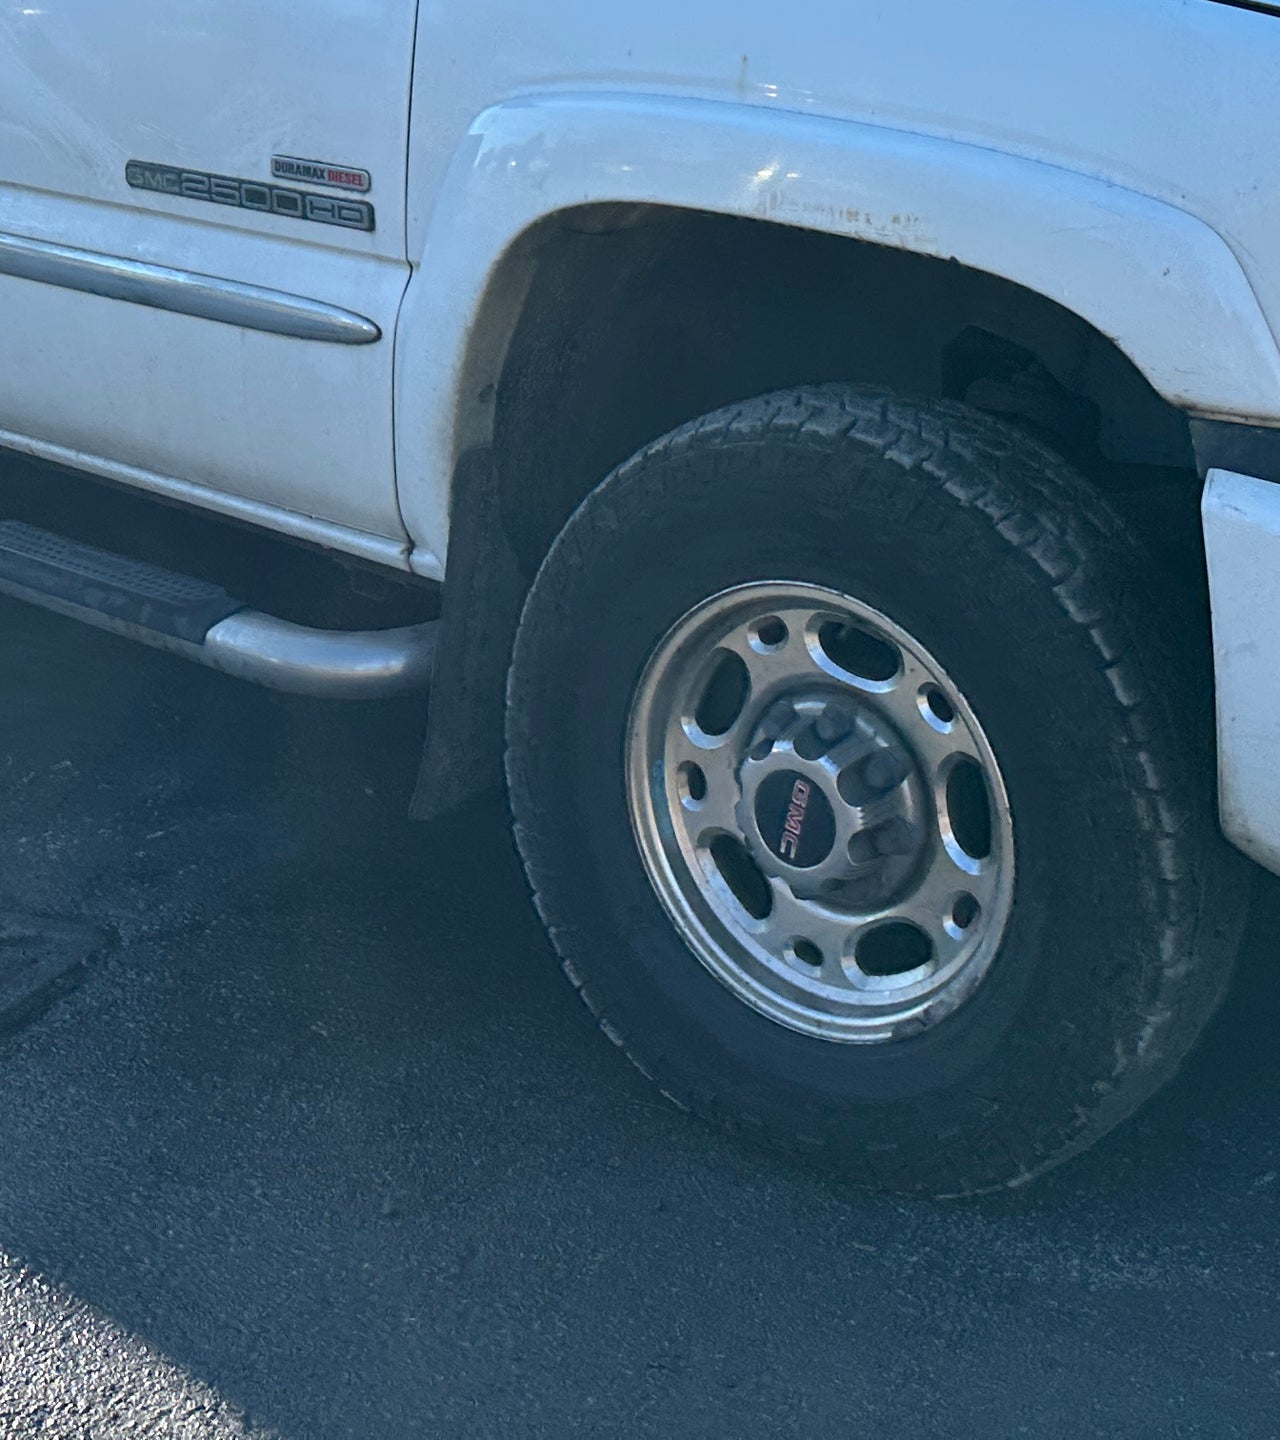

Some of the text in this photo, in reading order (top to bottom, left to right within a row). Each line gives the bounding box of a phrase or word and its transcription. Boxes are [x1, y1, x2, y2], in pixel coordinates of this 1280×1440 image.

[274, 160, 365, 188] DURAMAX DIESEL
[780, 778, 810, 860] GMC
